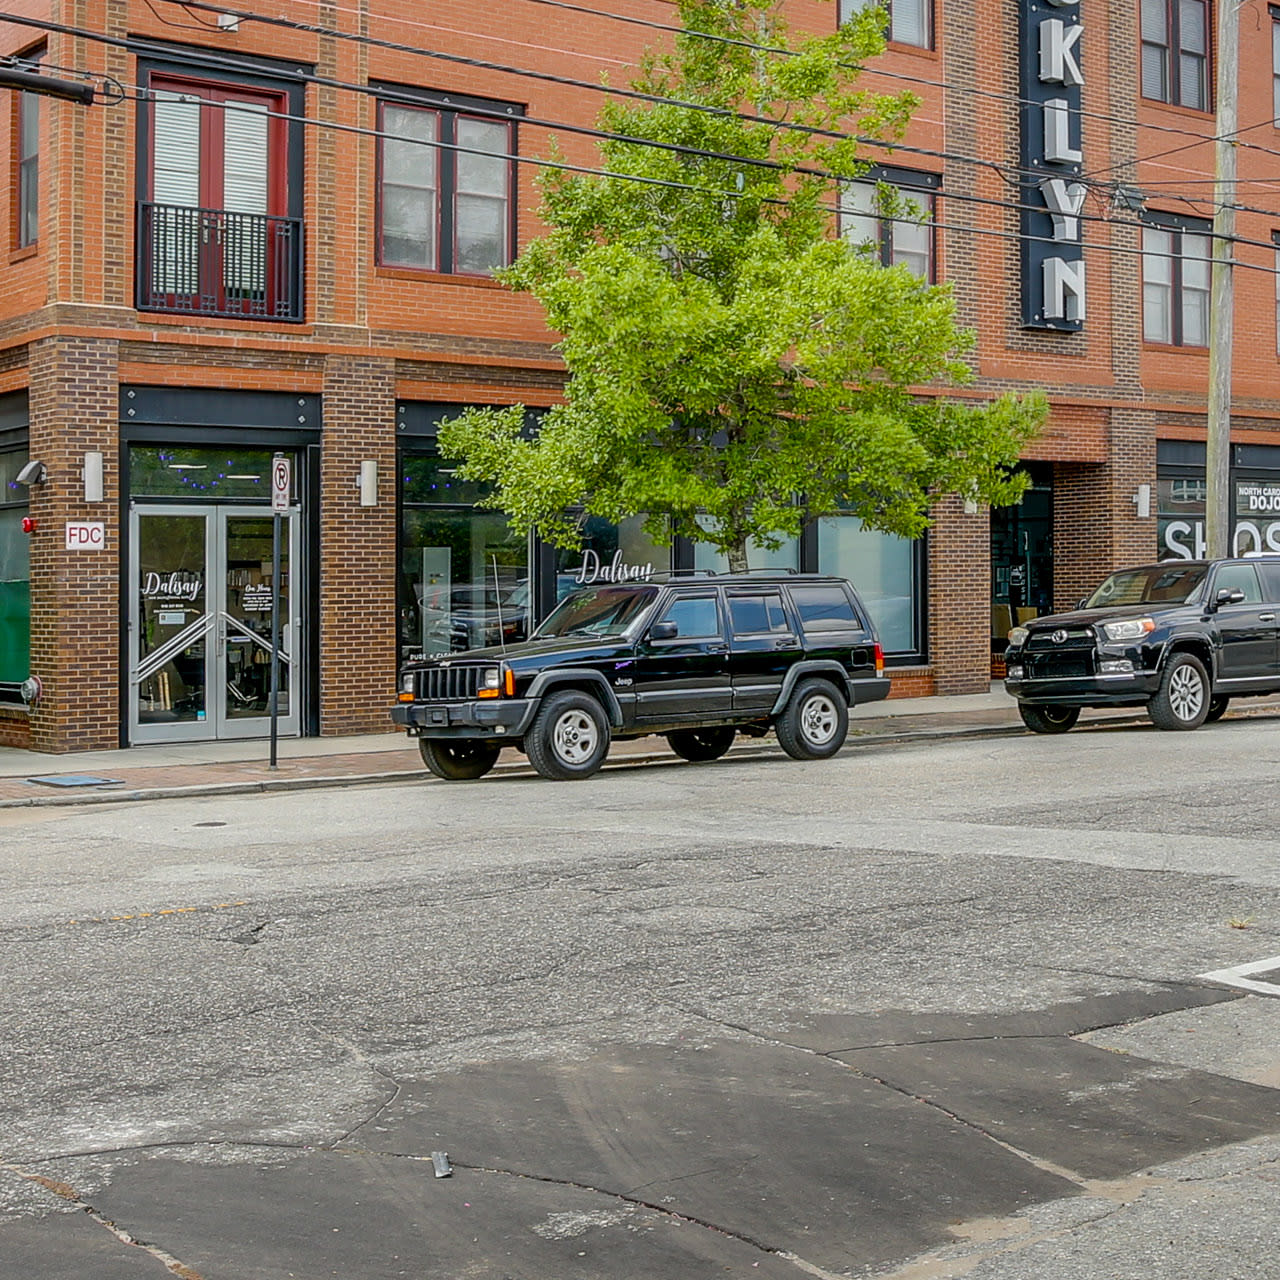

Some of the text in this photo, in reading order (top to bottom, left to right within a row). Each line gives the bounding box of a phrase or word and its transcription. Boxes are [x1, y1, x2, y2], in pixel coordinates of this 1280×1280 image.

[1238, 487, 1262, 496] NORTH
[68, 526, 102, 544] FDC
[564, 548, 656, 584] Dalisay
[142, 572, 202, 601] Dalisay
[614, 677, 633, 687] Jeep
